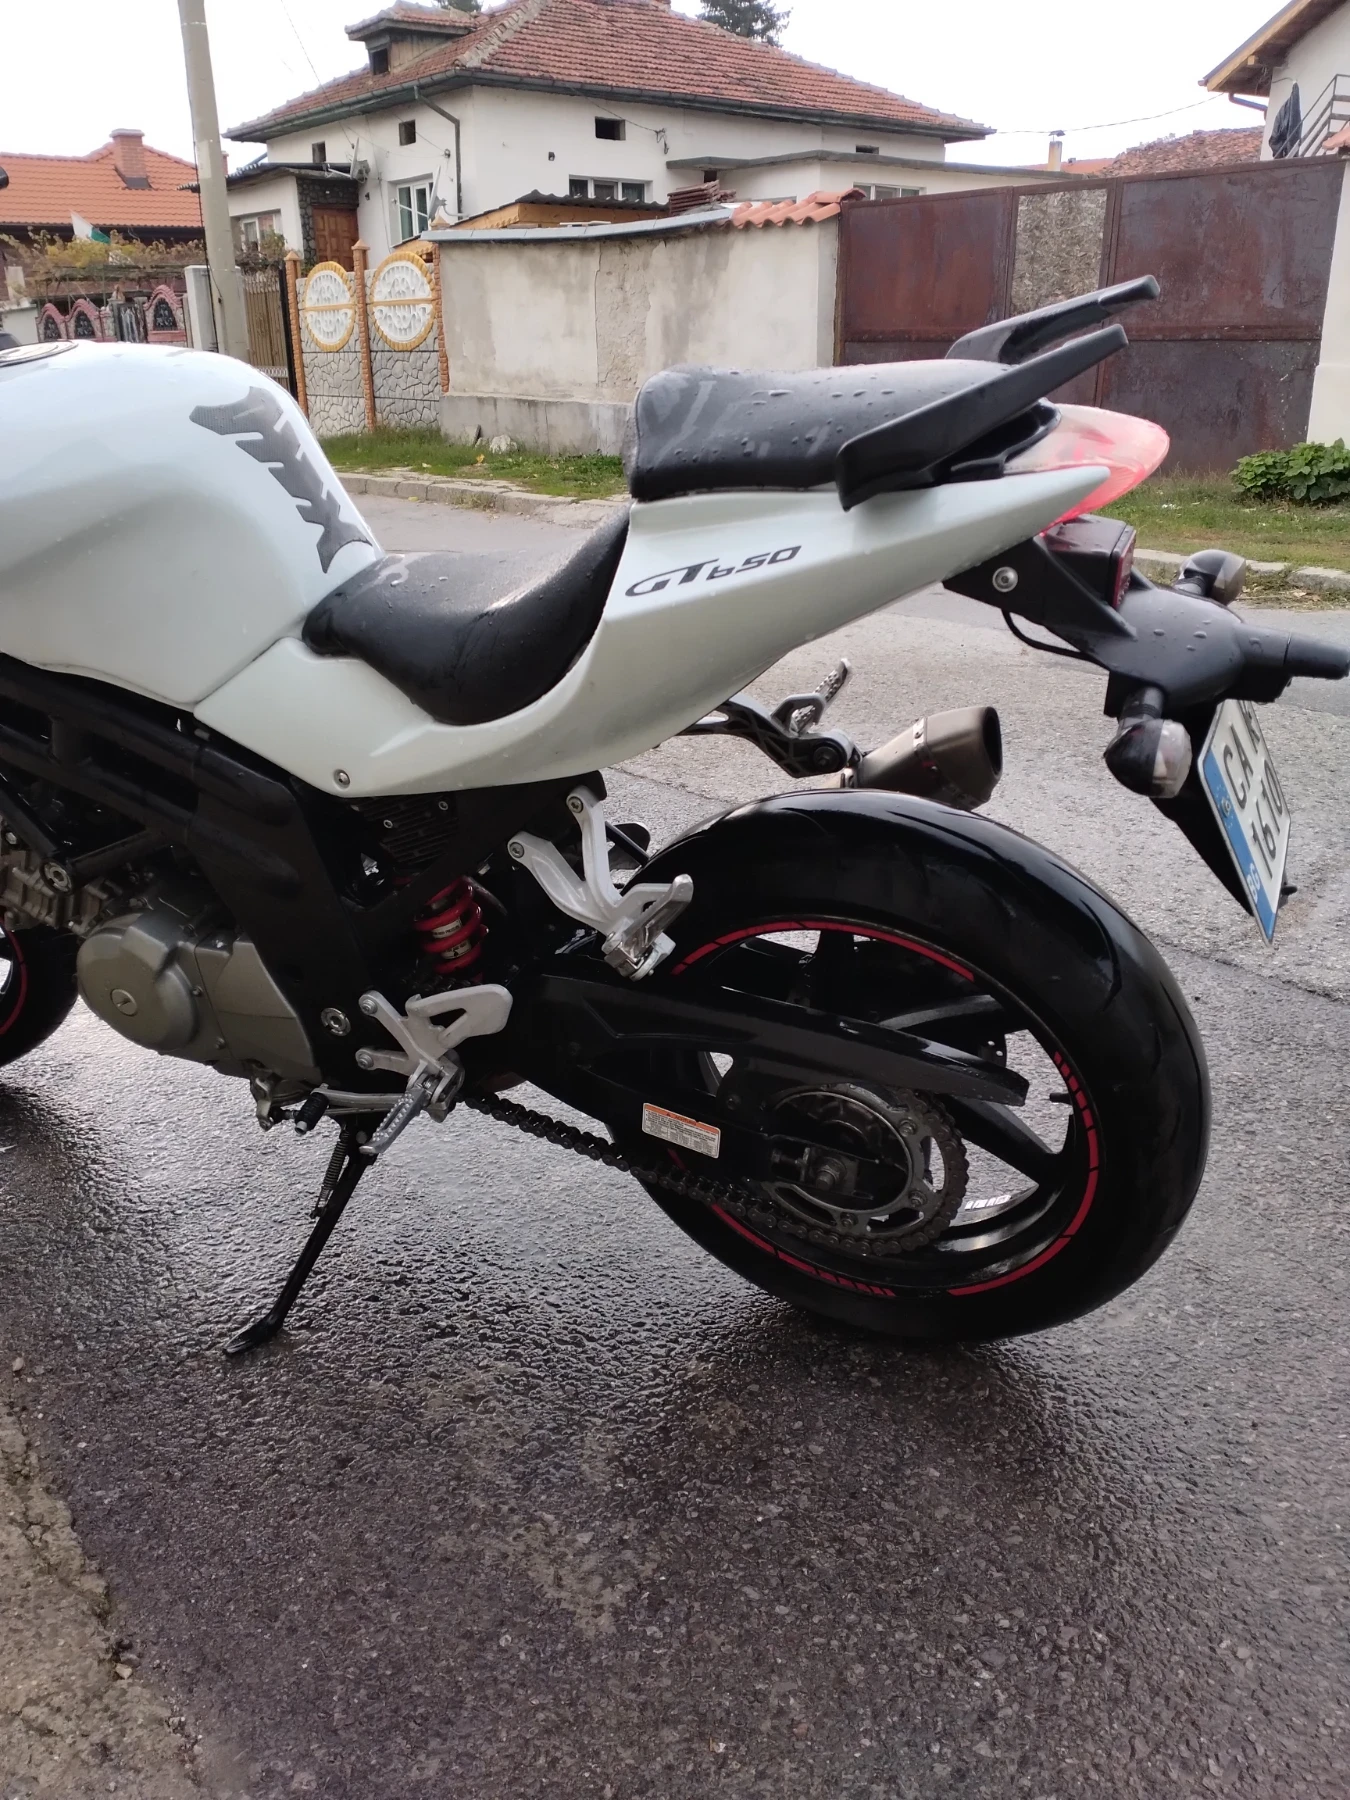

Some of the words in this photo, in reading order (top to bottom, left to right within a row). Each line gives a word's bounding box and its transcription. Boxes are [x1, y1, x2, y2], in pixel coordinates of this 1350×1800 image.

[625, 545, 802, 597] GT650
[1223, 723, 1254, 810] CA
[1250, 759, 1283, 880] 1610
[1246, 862, 1261, 904] BG
